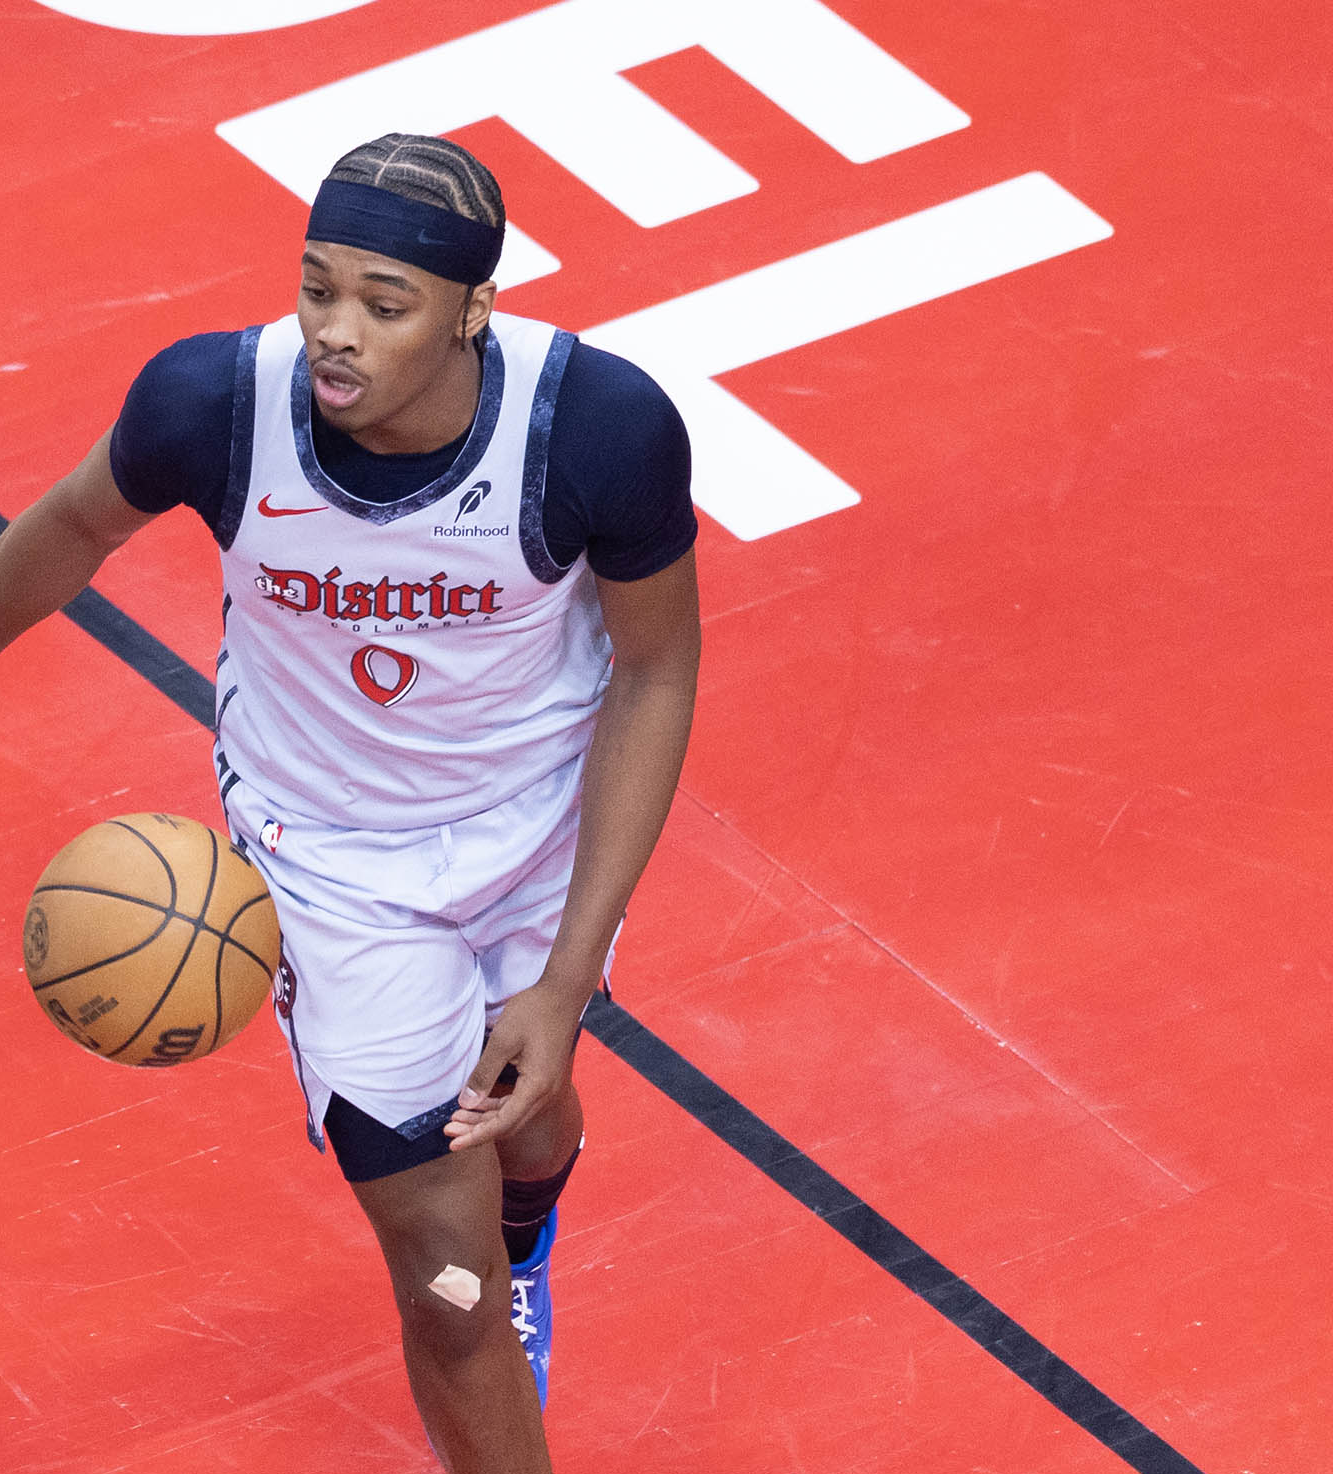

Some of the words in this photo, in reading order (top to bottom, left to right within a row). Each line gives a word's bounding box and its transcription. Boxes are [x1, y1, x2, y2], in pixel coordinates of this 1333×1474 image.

[433, 525, 509, 538] Robinhood
[254, 576, 298, 600] the
[259, 562, 504, 622] District
[350, 644, 420, 708] 0
